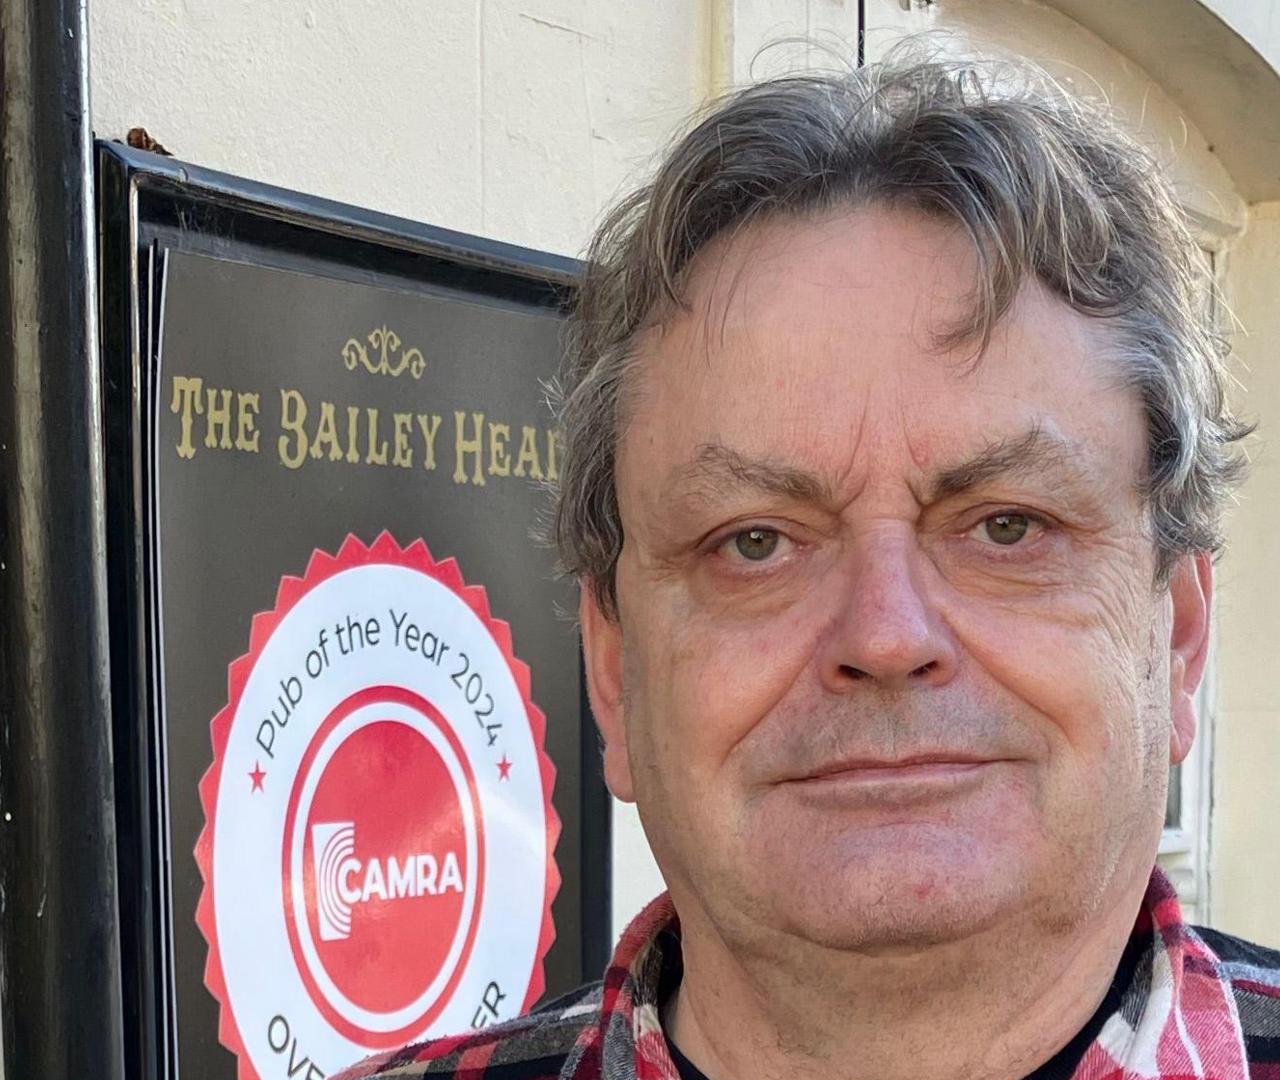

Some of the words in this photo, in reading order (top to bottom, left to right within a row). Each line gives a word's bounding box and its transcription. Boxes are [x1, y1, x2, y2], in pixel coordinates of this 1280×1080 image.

[171, 376, 260, 460] THE
[278, 389, 442, 470] BAILEY
[256, 677, 303, 759] Pub
[306, 629, 329, 679] of
[336, 616, 380, 655] the
[389, 609, 450, 666] Year
[450, 653, 503, 746] 2024
[338, 852, 464, 904] CAMRA
